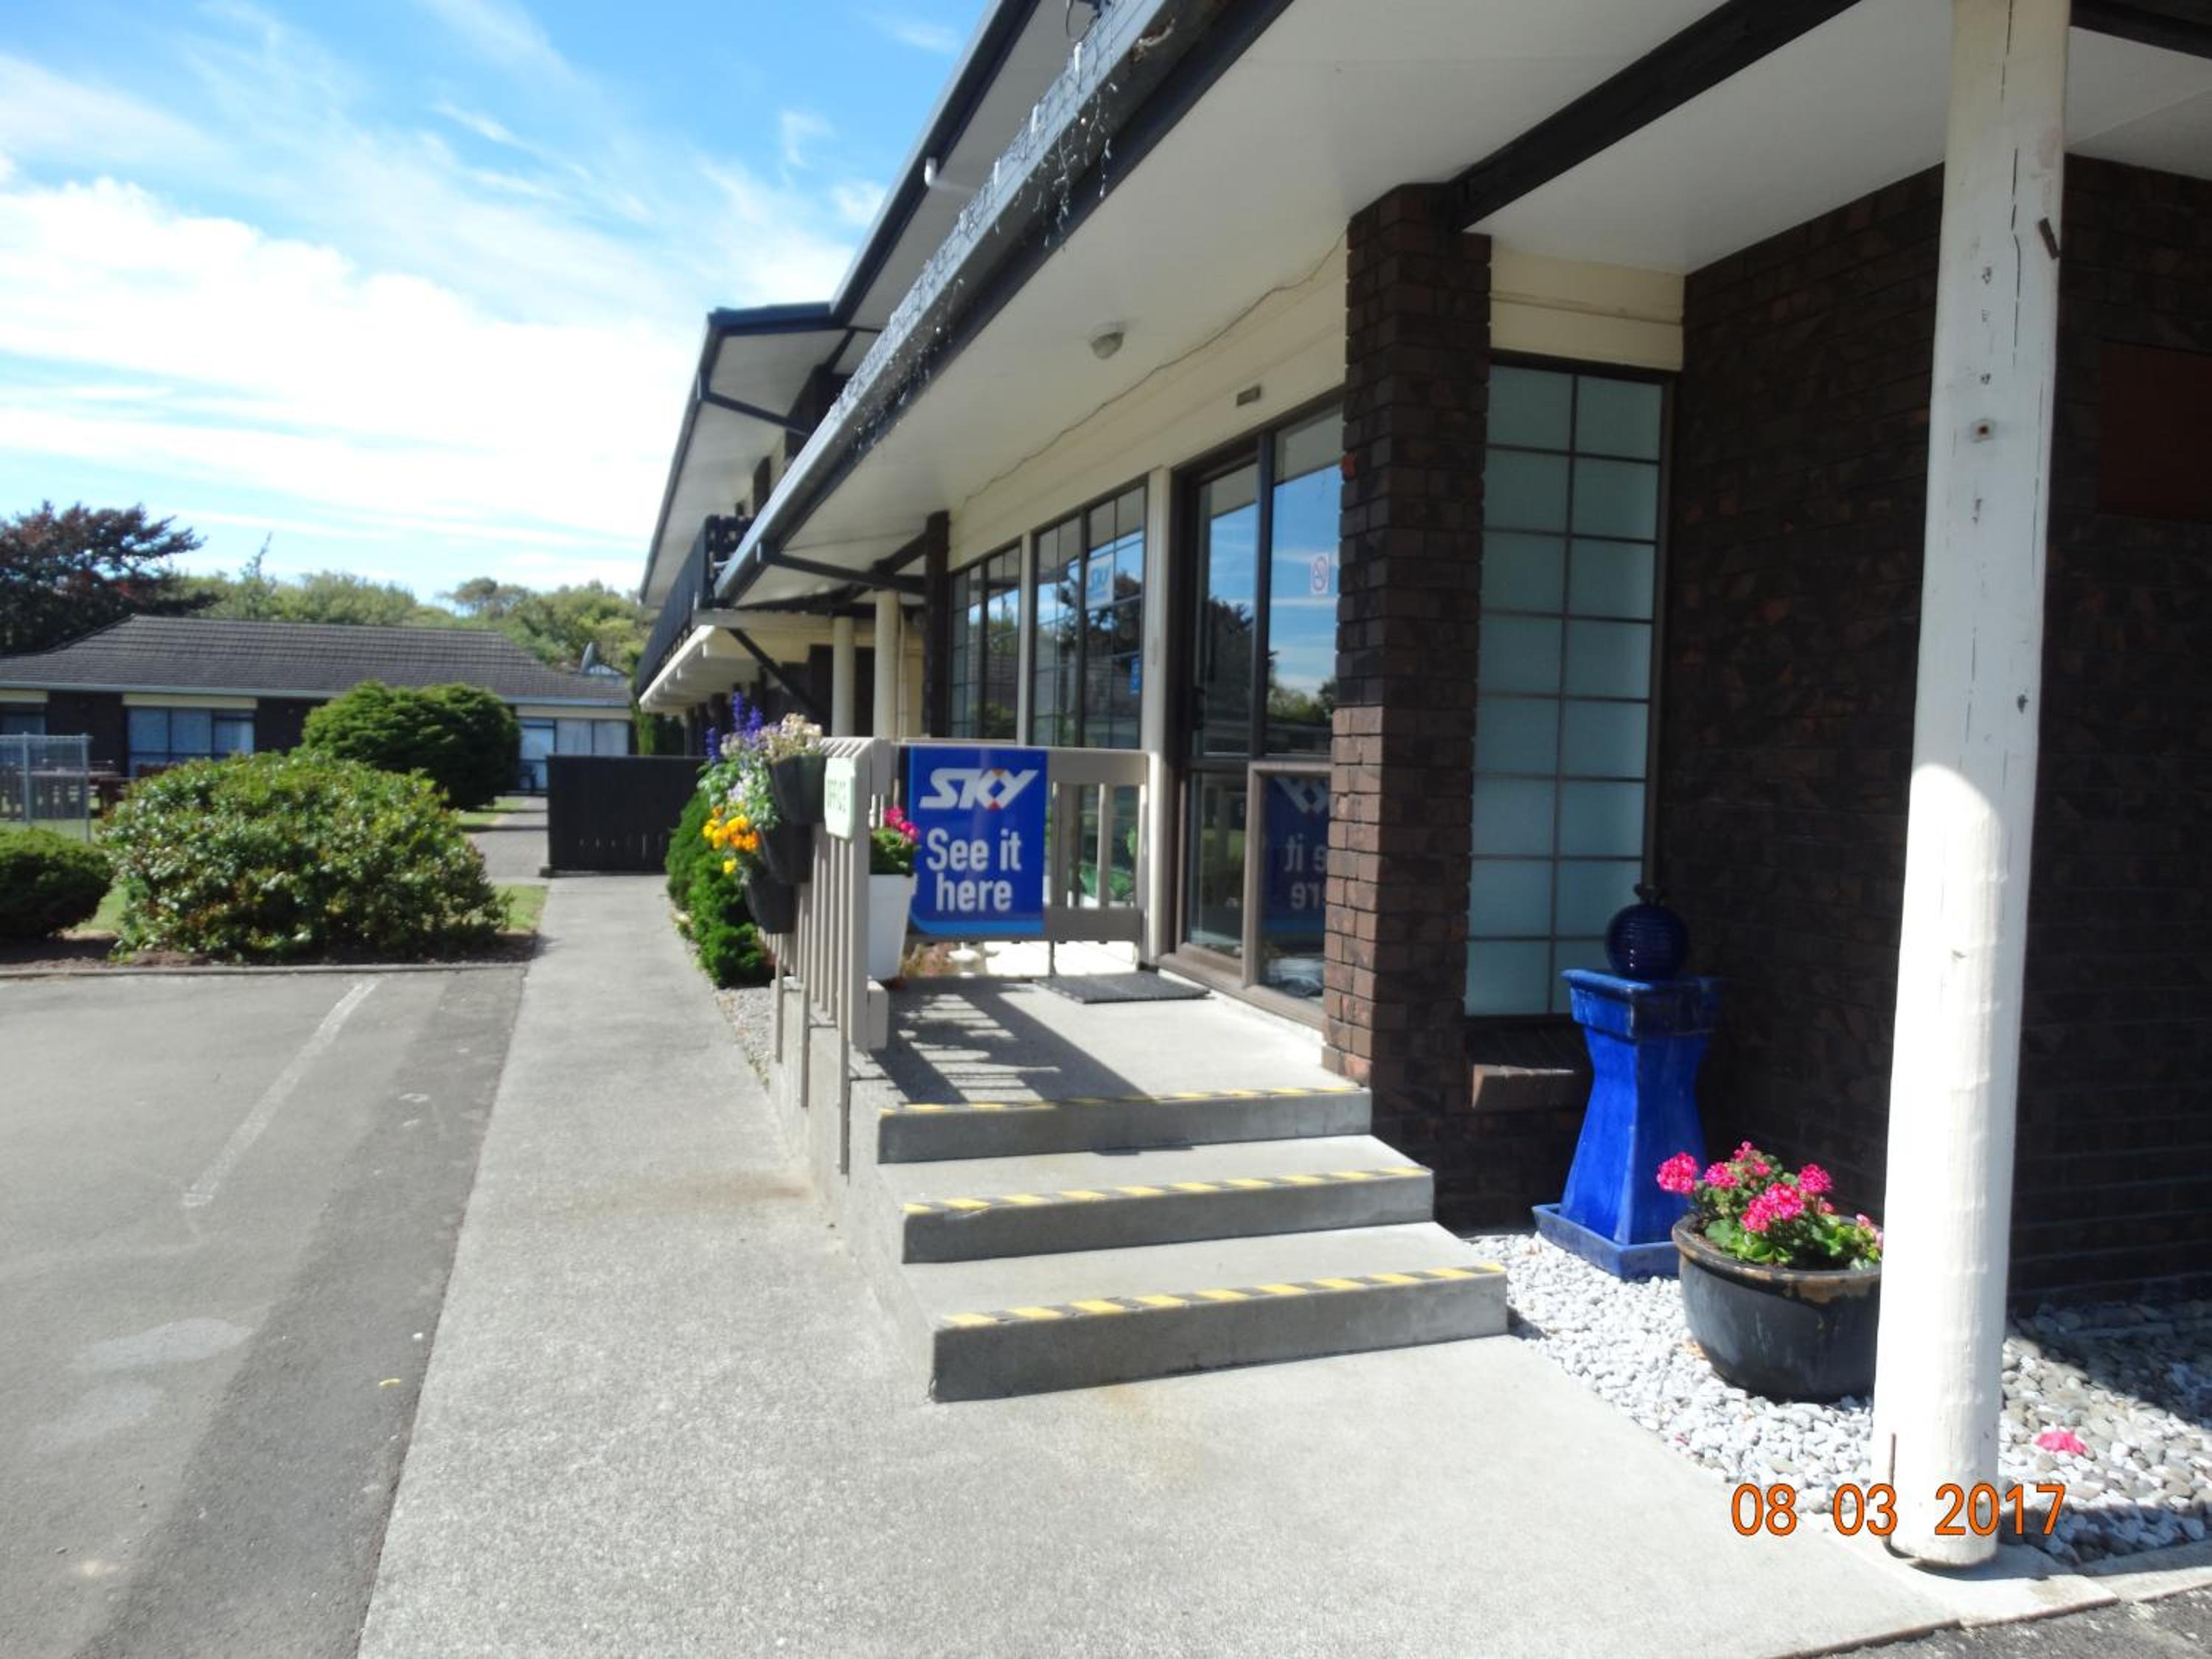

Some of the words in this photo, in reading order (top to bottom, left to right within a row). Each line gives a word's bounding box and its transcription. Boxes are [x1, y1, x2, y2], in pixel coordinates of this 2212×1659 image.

[919, 768, 1039, 810] SKY
[926, 827, 990, 872] See
[1000, 827, 1023, 872] it
[936, 874, 1012, 912] here
